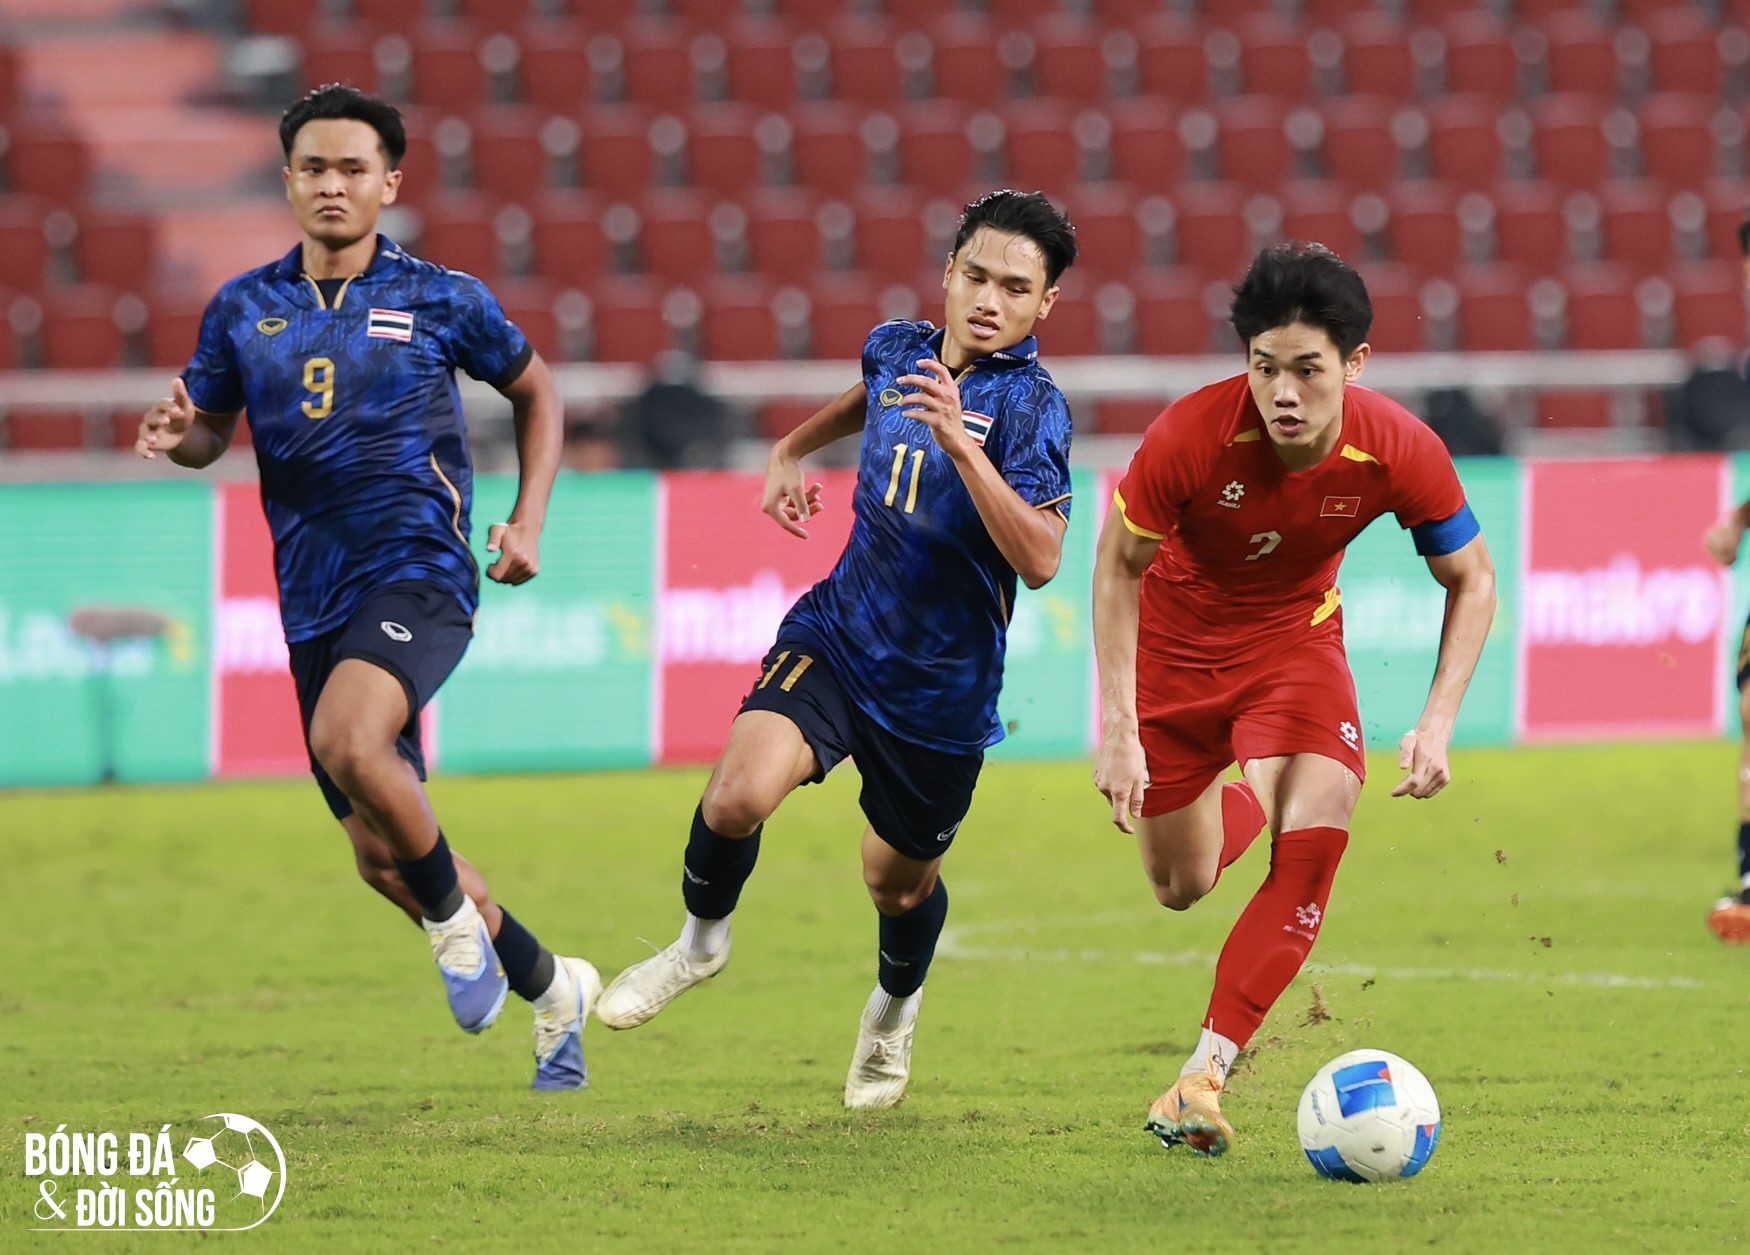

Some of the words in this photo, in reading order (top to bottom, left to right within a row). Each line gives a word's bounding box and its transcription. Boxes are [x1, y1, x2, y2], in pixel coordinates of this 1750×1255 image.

[302, 357, 335, 419] 9
[884, 443, 925, 514] 11
[757, 650, 813, 692] 11
